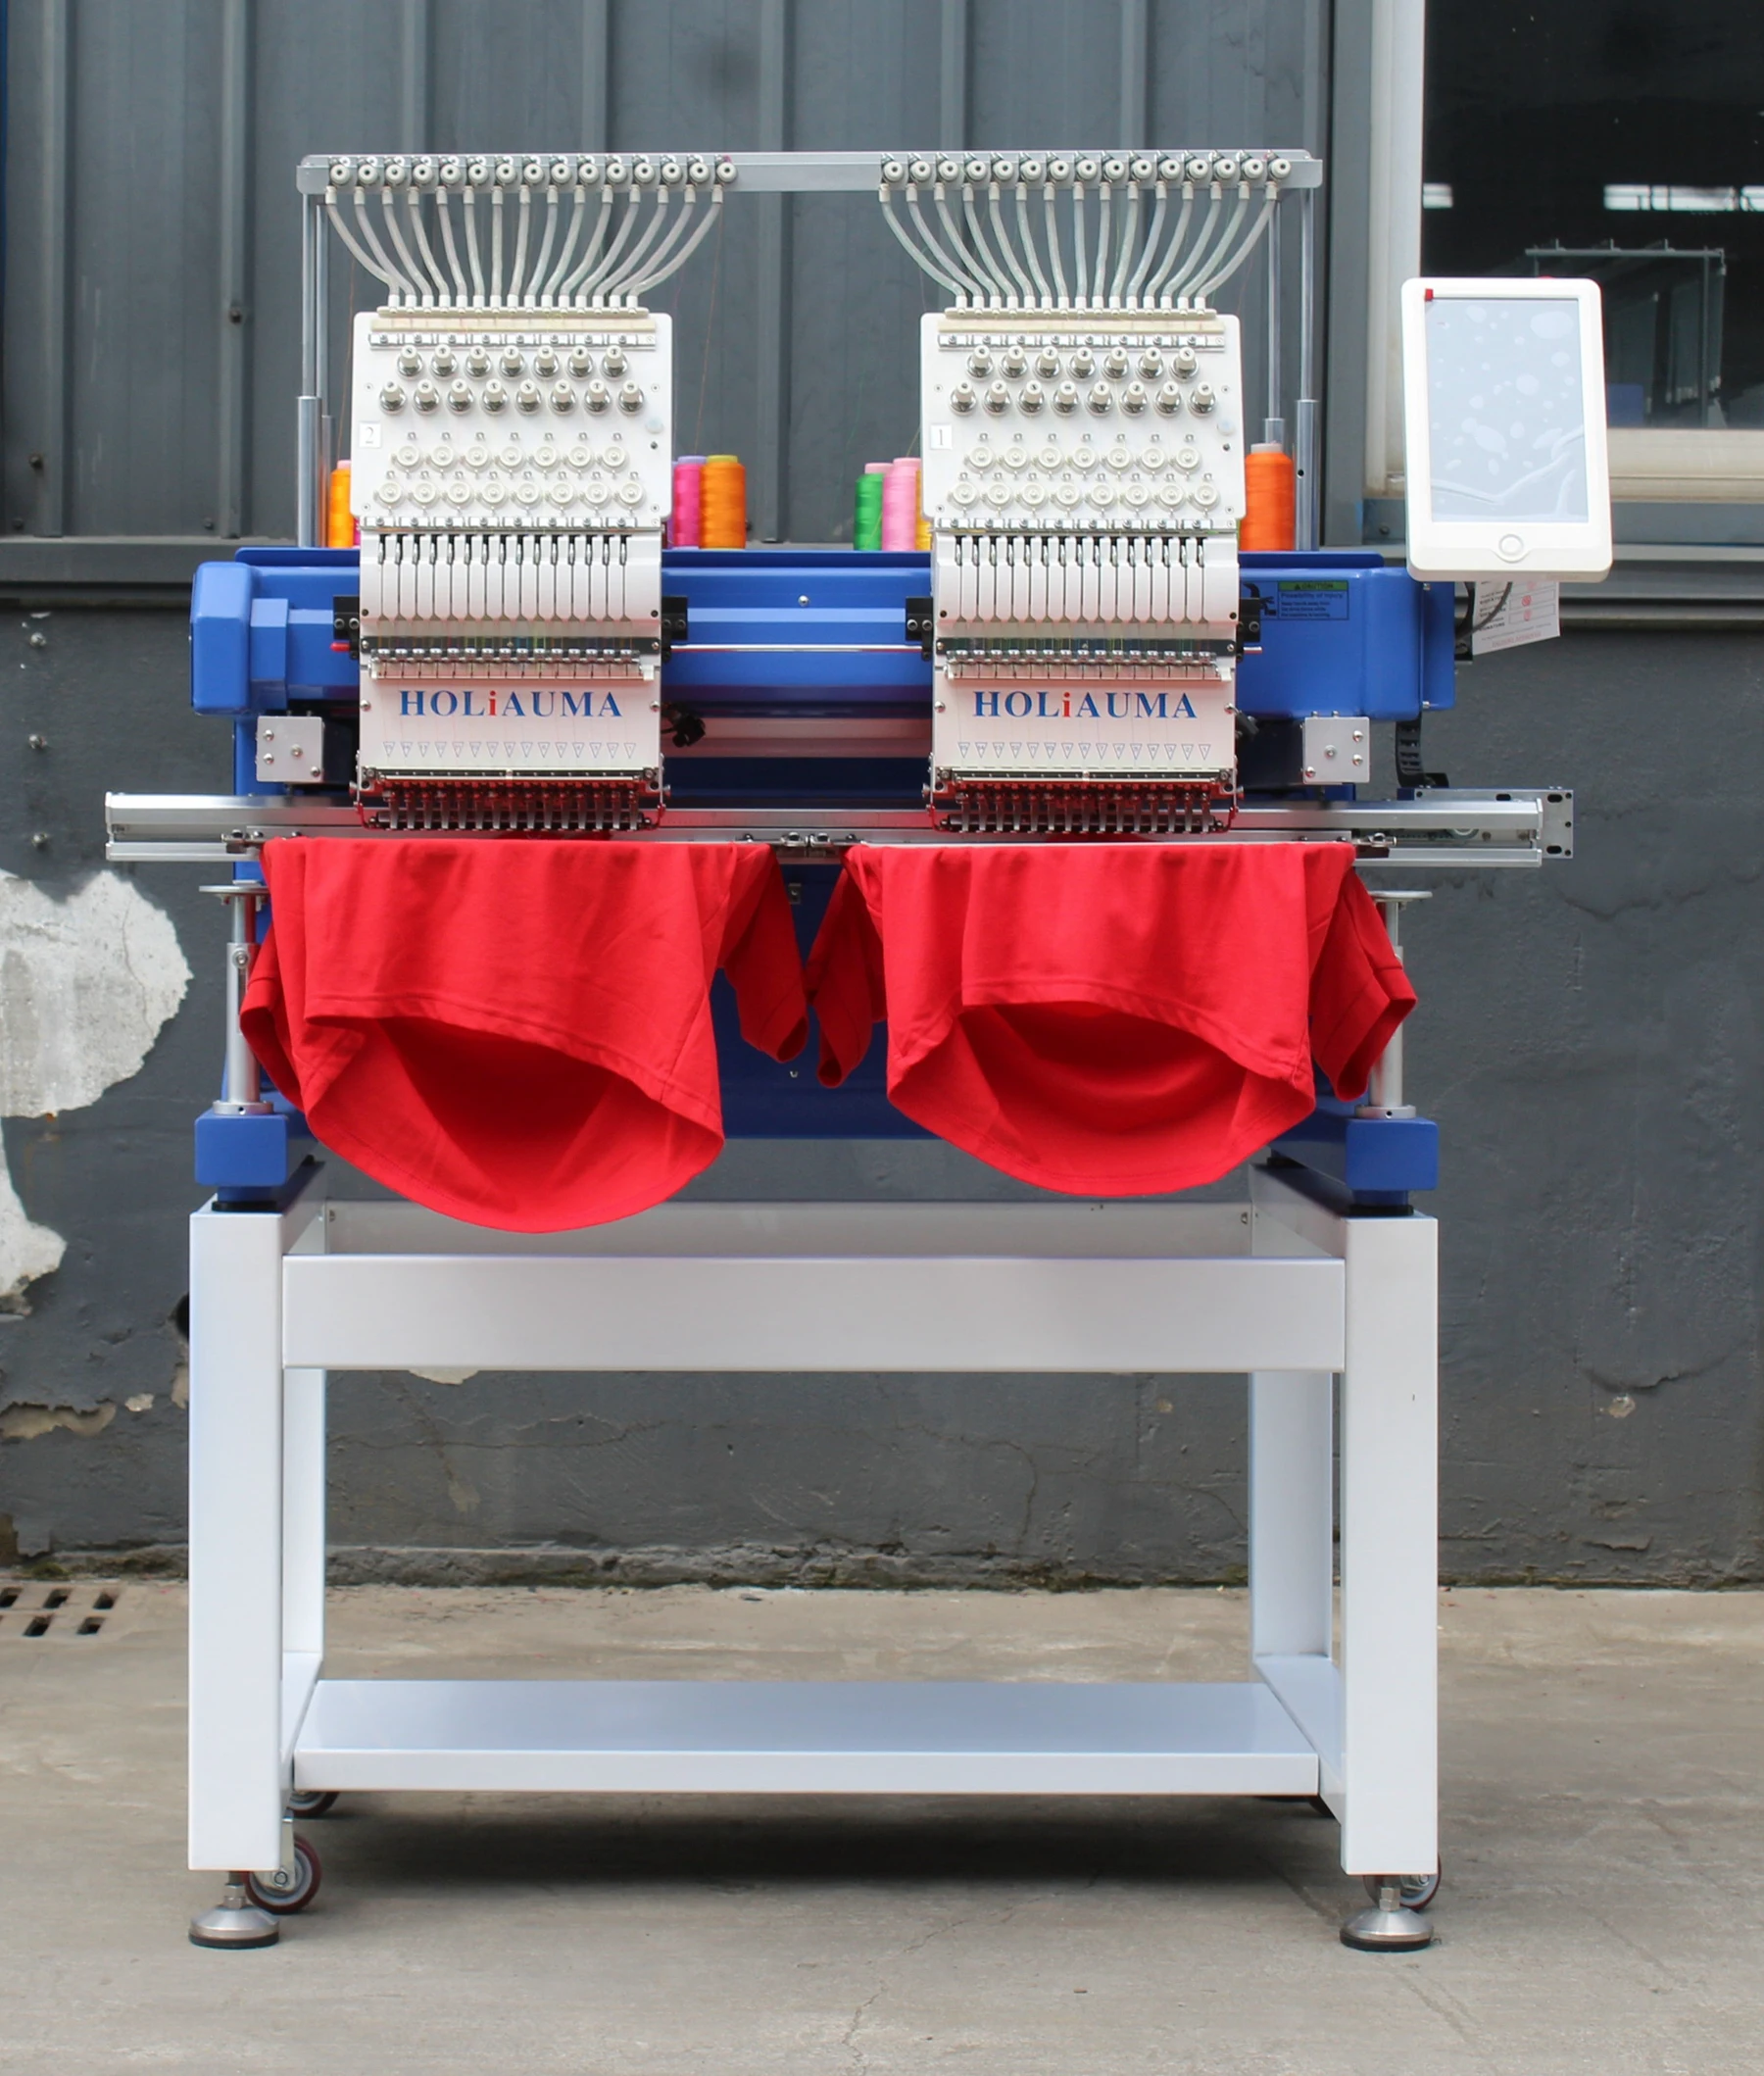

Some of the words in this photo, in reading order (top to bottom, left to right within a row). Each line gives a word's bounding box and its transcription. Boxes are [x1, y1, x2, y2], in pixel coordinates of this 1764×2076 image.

[365, 426, 374, 444] 2
[938, 429, 944, 445] 1
[399, 690, 623, 717] HOLiAUMA
[972, 691, 1198, 717] HOLiAUMA
